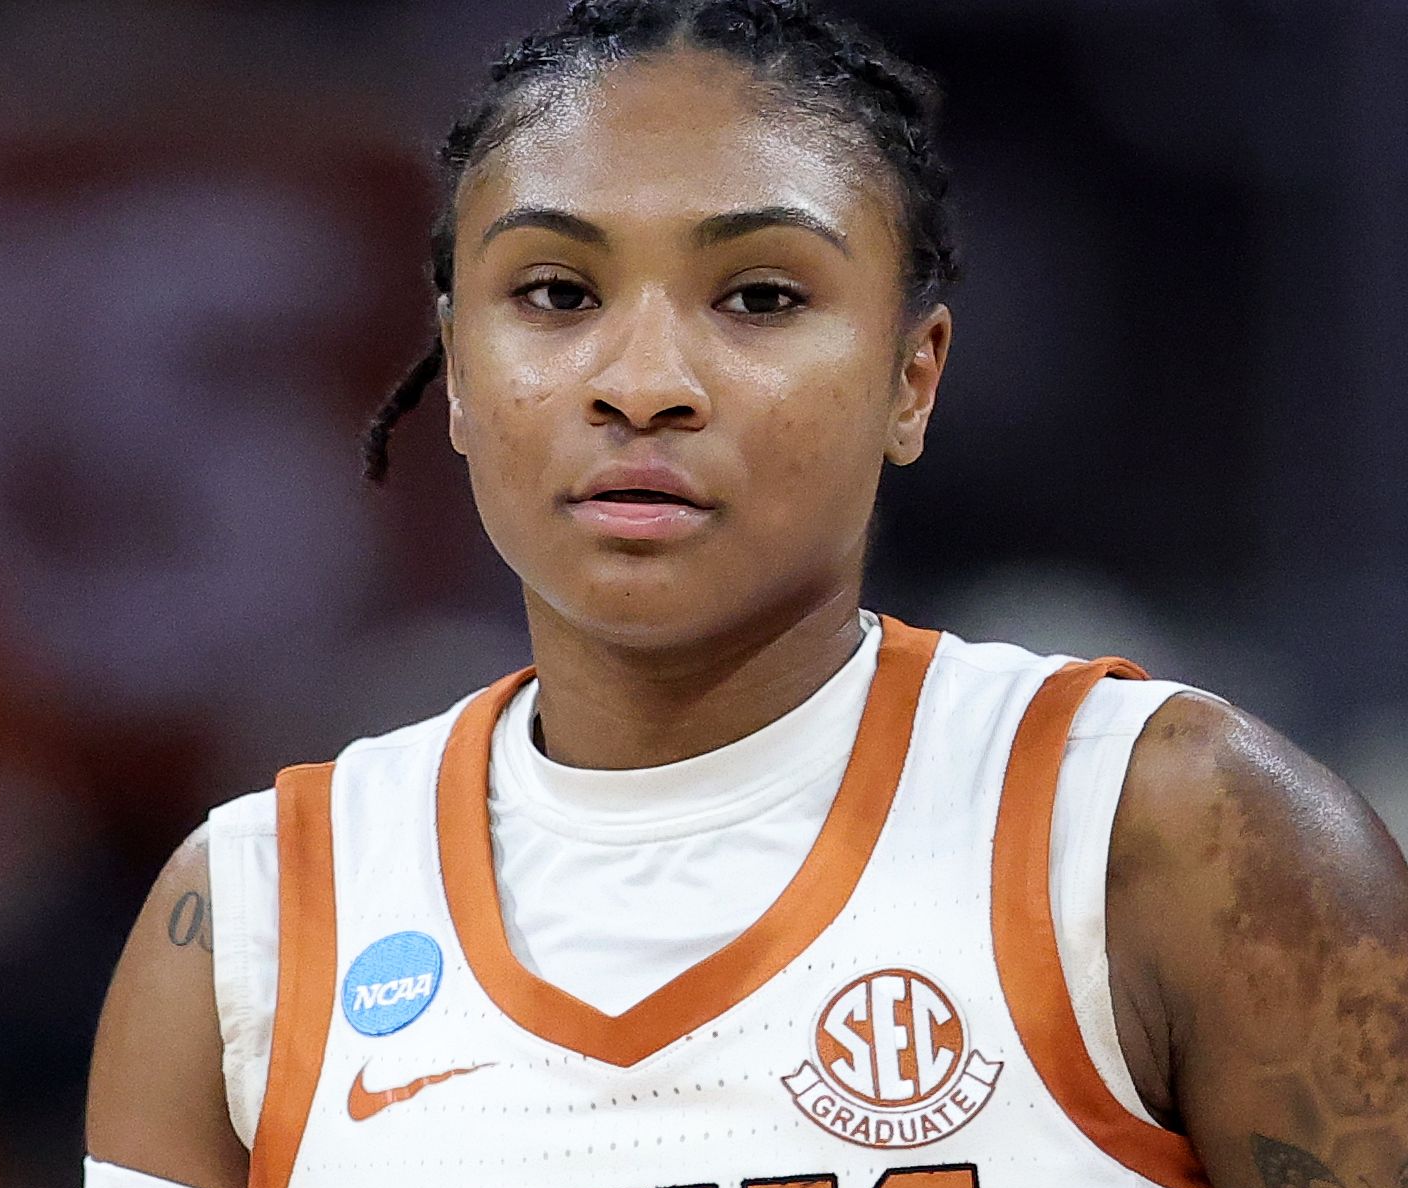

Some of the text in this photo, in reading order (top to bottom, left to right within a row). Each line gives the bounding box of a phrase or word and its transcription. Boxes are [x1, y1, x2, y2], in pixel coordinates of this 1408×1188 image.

[352, 972, 433, 1012] NCAA
[823, 975, 956, 1102] SEC
[811, 1088, 977, 1144] GRADUATE
